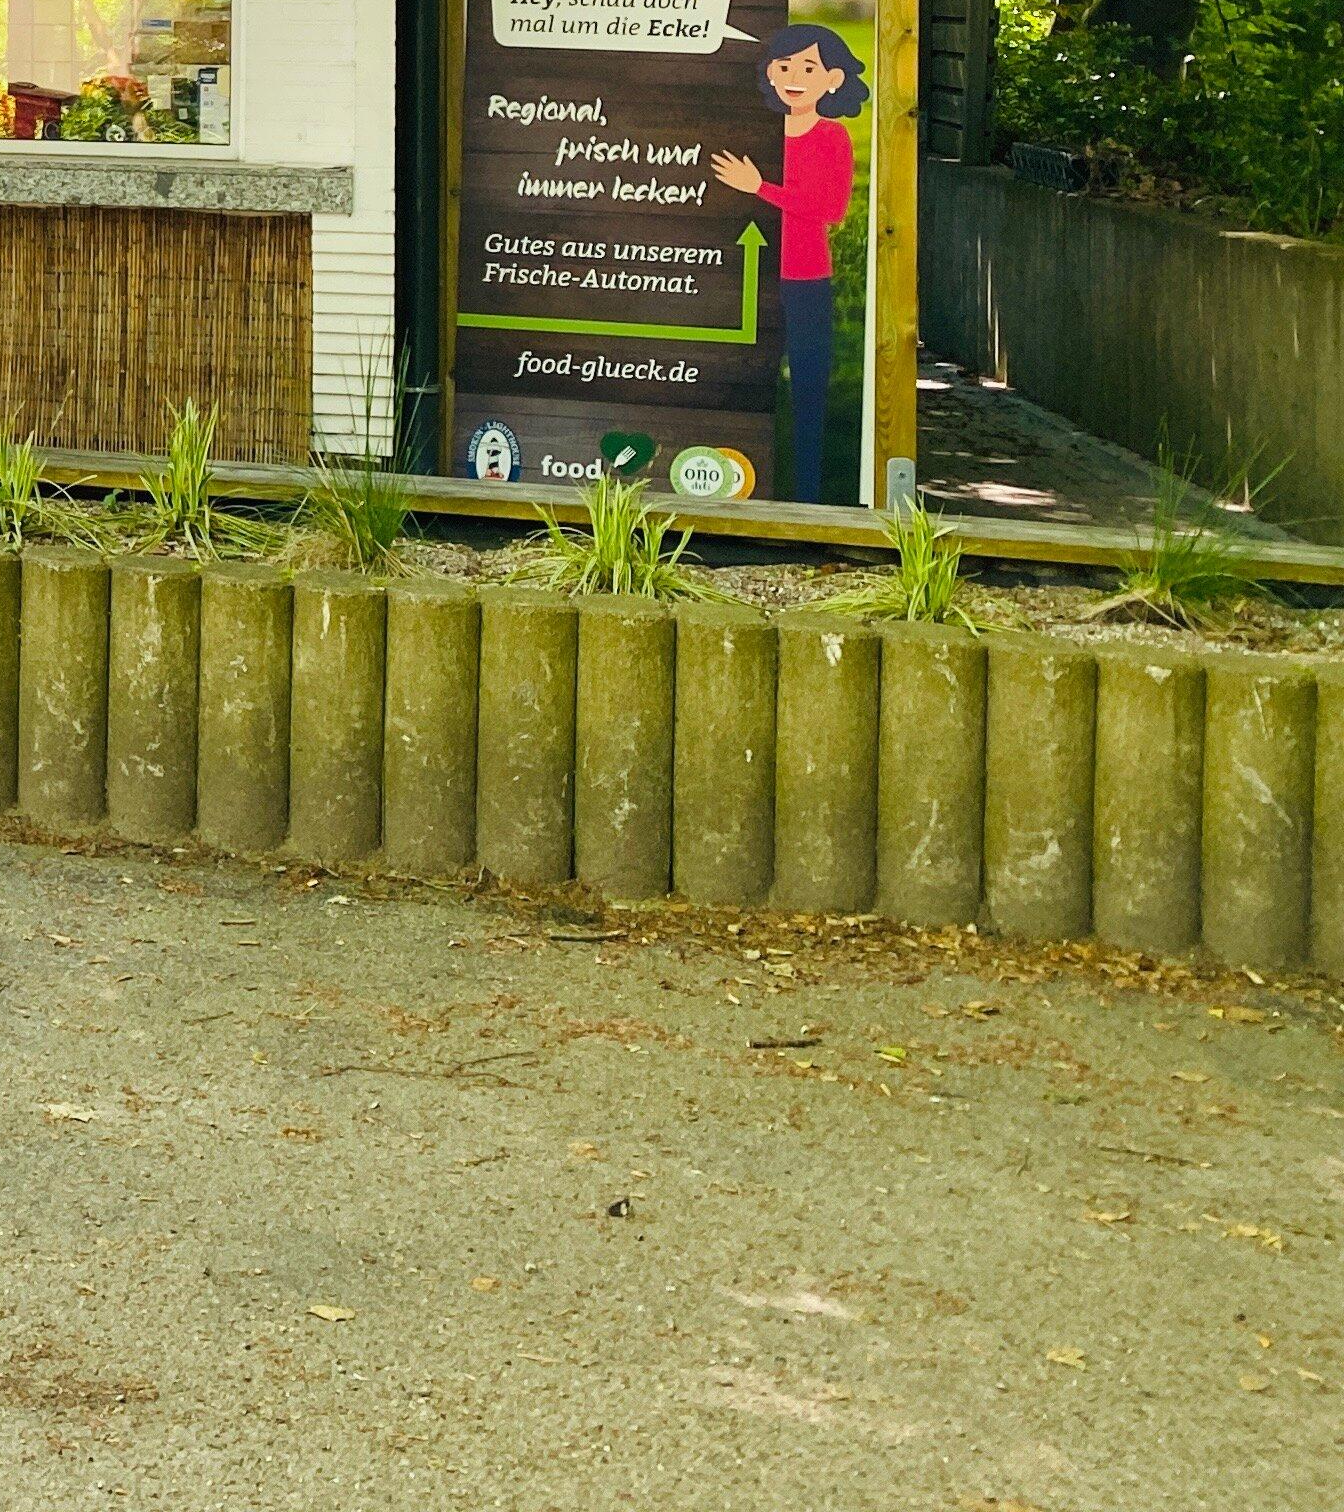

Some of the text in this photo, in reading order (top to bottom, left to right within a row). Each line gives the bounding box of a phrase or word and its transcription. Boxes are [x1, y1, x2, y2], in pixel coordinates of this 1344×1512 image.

[510, 14, 710, 39] mal um die Ecke!
[487, 94, 608, 127] Regional,
[554, 135, 702, 166] frisch und
[517, 171, 707, 206] immer lecker!
[484, 233, 723, 266] Gutes aus unserem
[482, 262, 700, 295] Frische-Automat.
[514, 349, 700, 384] food-glueck.de
[540, 454, 603, 480] food
[684, 468, 720, 482] ono
